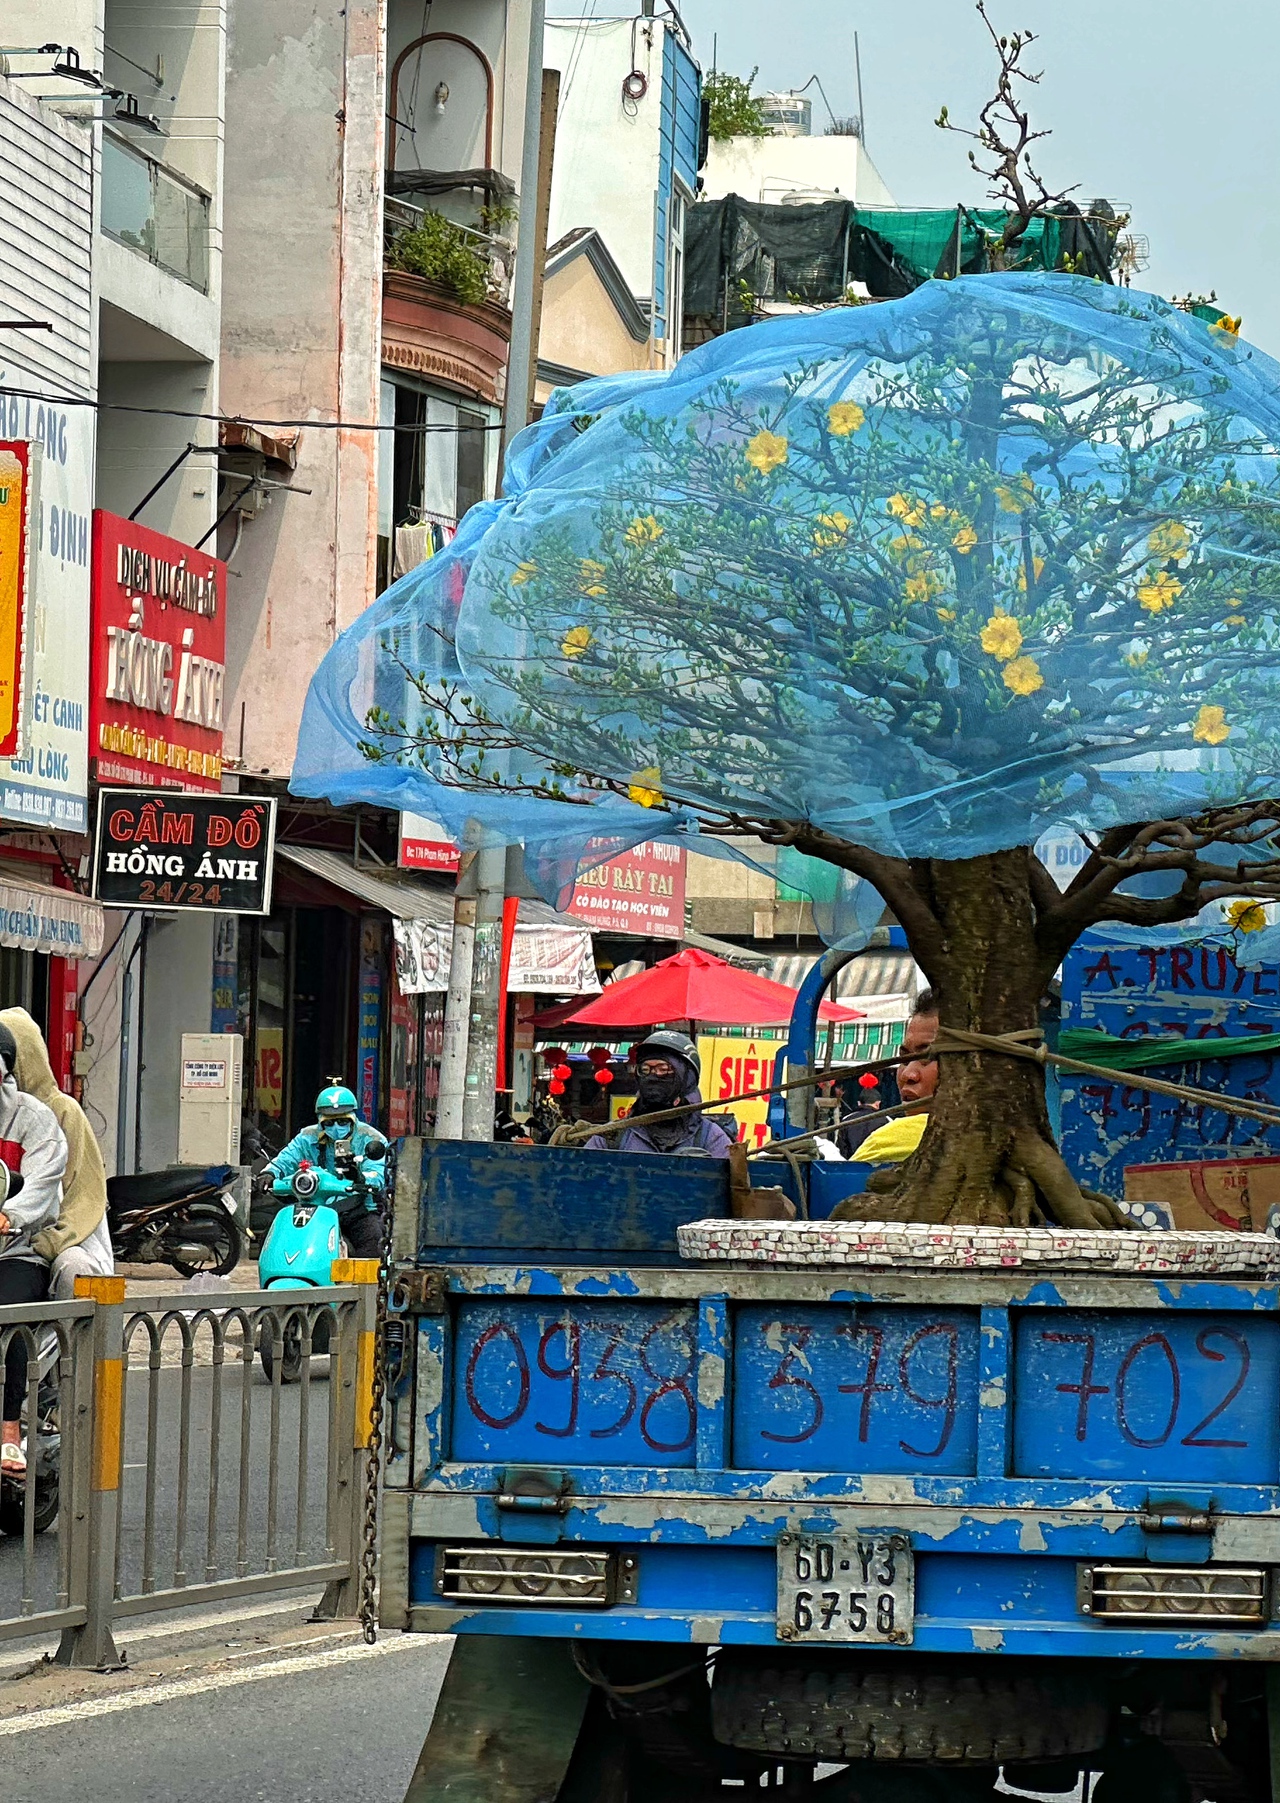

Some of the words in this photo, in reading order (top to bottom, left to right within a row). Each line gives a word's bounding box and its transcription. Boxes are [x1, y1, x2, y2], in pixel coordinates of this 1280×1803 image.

[117, 544, 150, 597] DỊCH
[151, 557, 171, 610] VỤ
[106, 597, 173, 715] HỒNG
[174, 628, 226, 729] ÁNH
[53, 697, 83, 732] CANH
[38, 742, 69, 781] LÒNG
[109, 799, 194, 844] CẦM
[206, 805, 264, 849] ĐỒ
[106, 844, 185, 876] HỒNG
[194, 851, 259, 881] ÁNH
[138, 880, 222, 905] 24/24
[648, 872, 674, 897] TAI
[576, 893, 588, 907] CÓ
[590, 896, 610, 909] ĐÀO
[611, 900, 628, 914] TẠO
[630, 902, 648, 916] HỌC
[650, 903, 670, 918] VIÊN
[1041, 1325, 1252, 1450] 702
[794, 1591, 895, 1634] 6758
